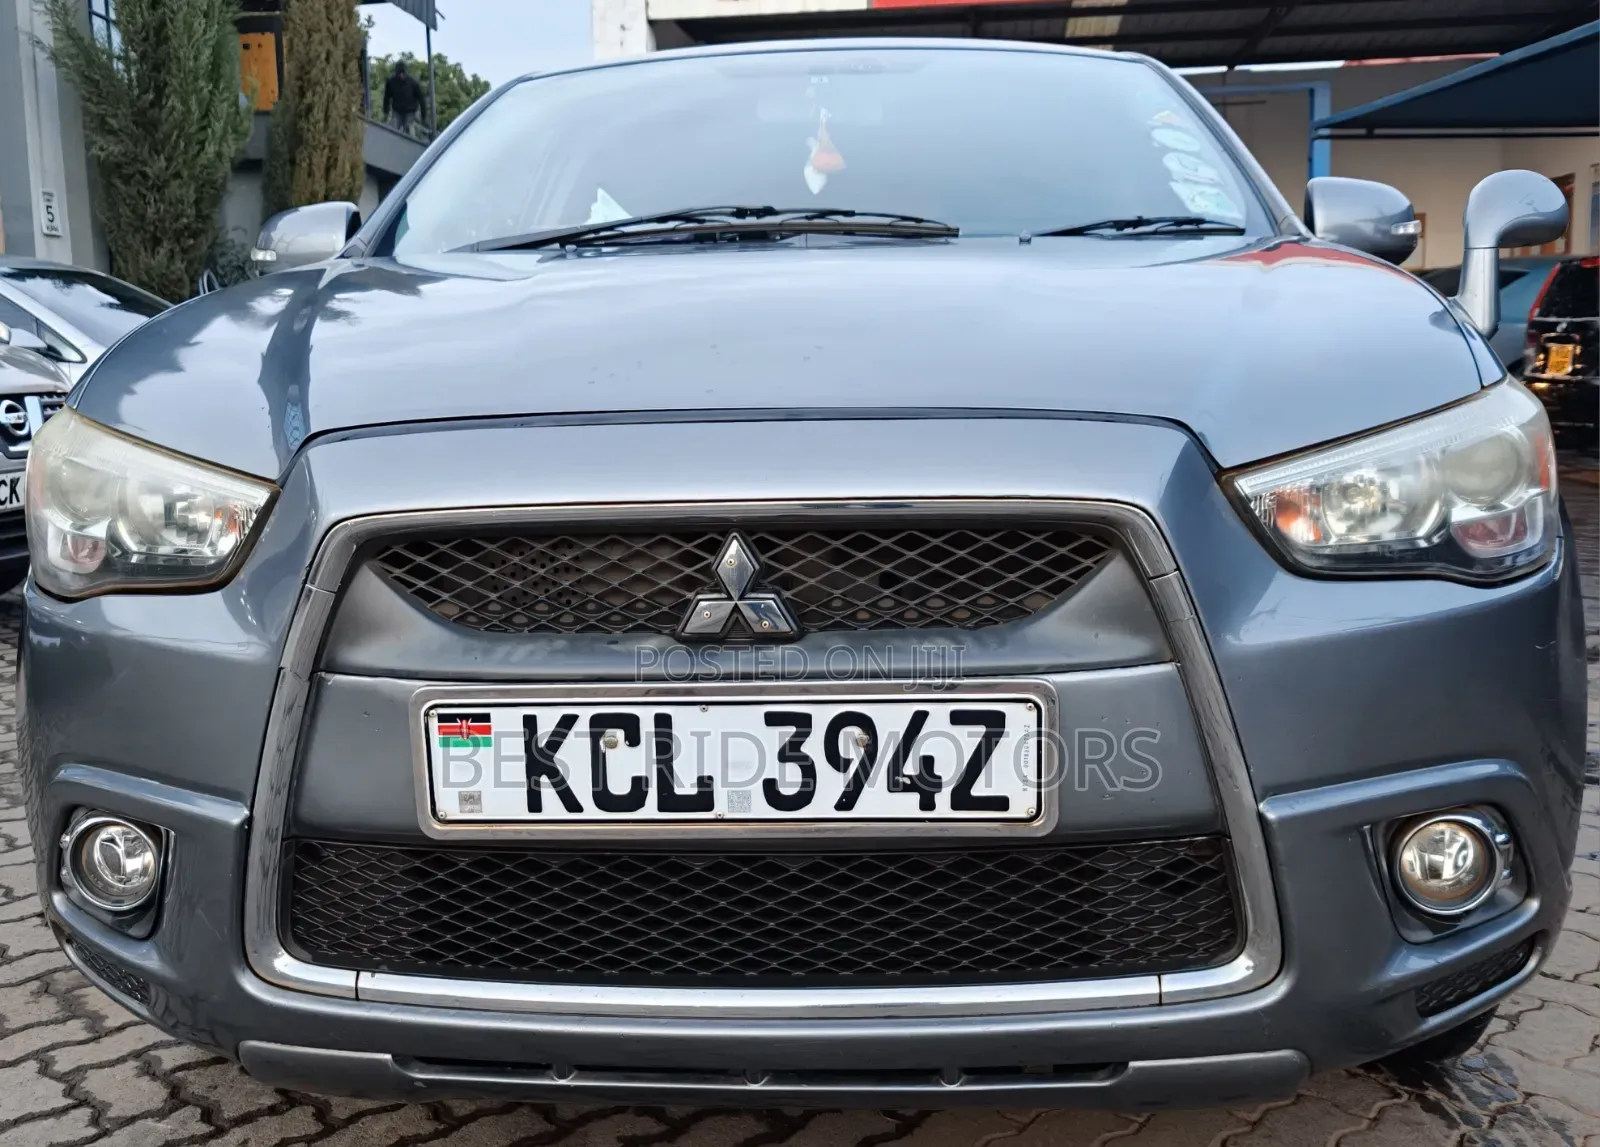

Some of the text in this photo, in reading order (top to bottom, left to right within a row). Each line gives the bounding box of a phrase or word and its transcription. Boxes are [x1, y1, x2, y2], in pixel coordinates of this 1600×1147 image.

[46, 205, 55, 223] 5
[522, 712, 715, 814] KCL
[762, 709, 1010, 812] 394Z
